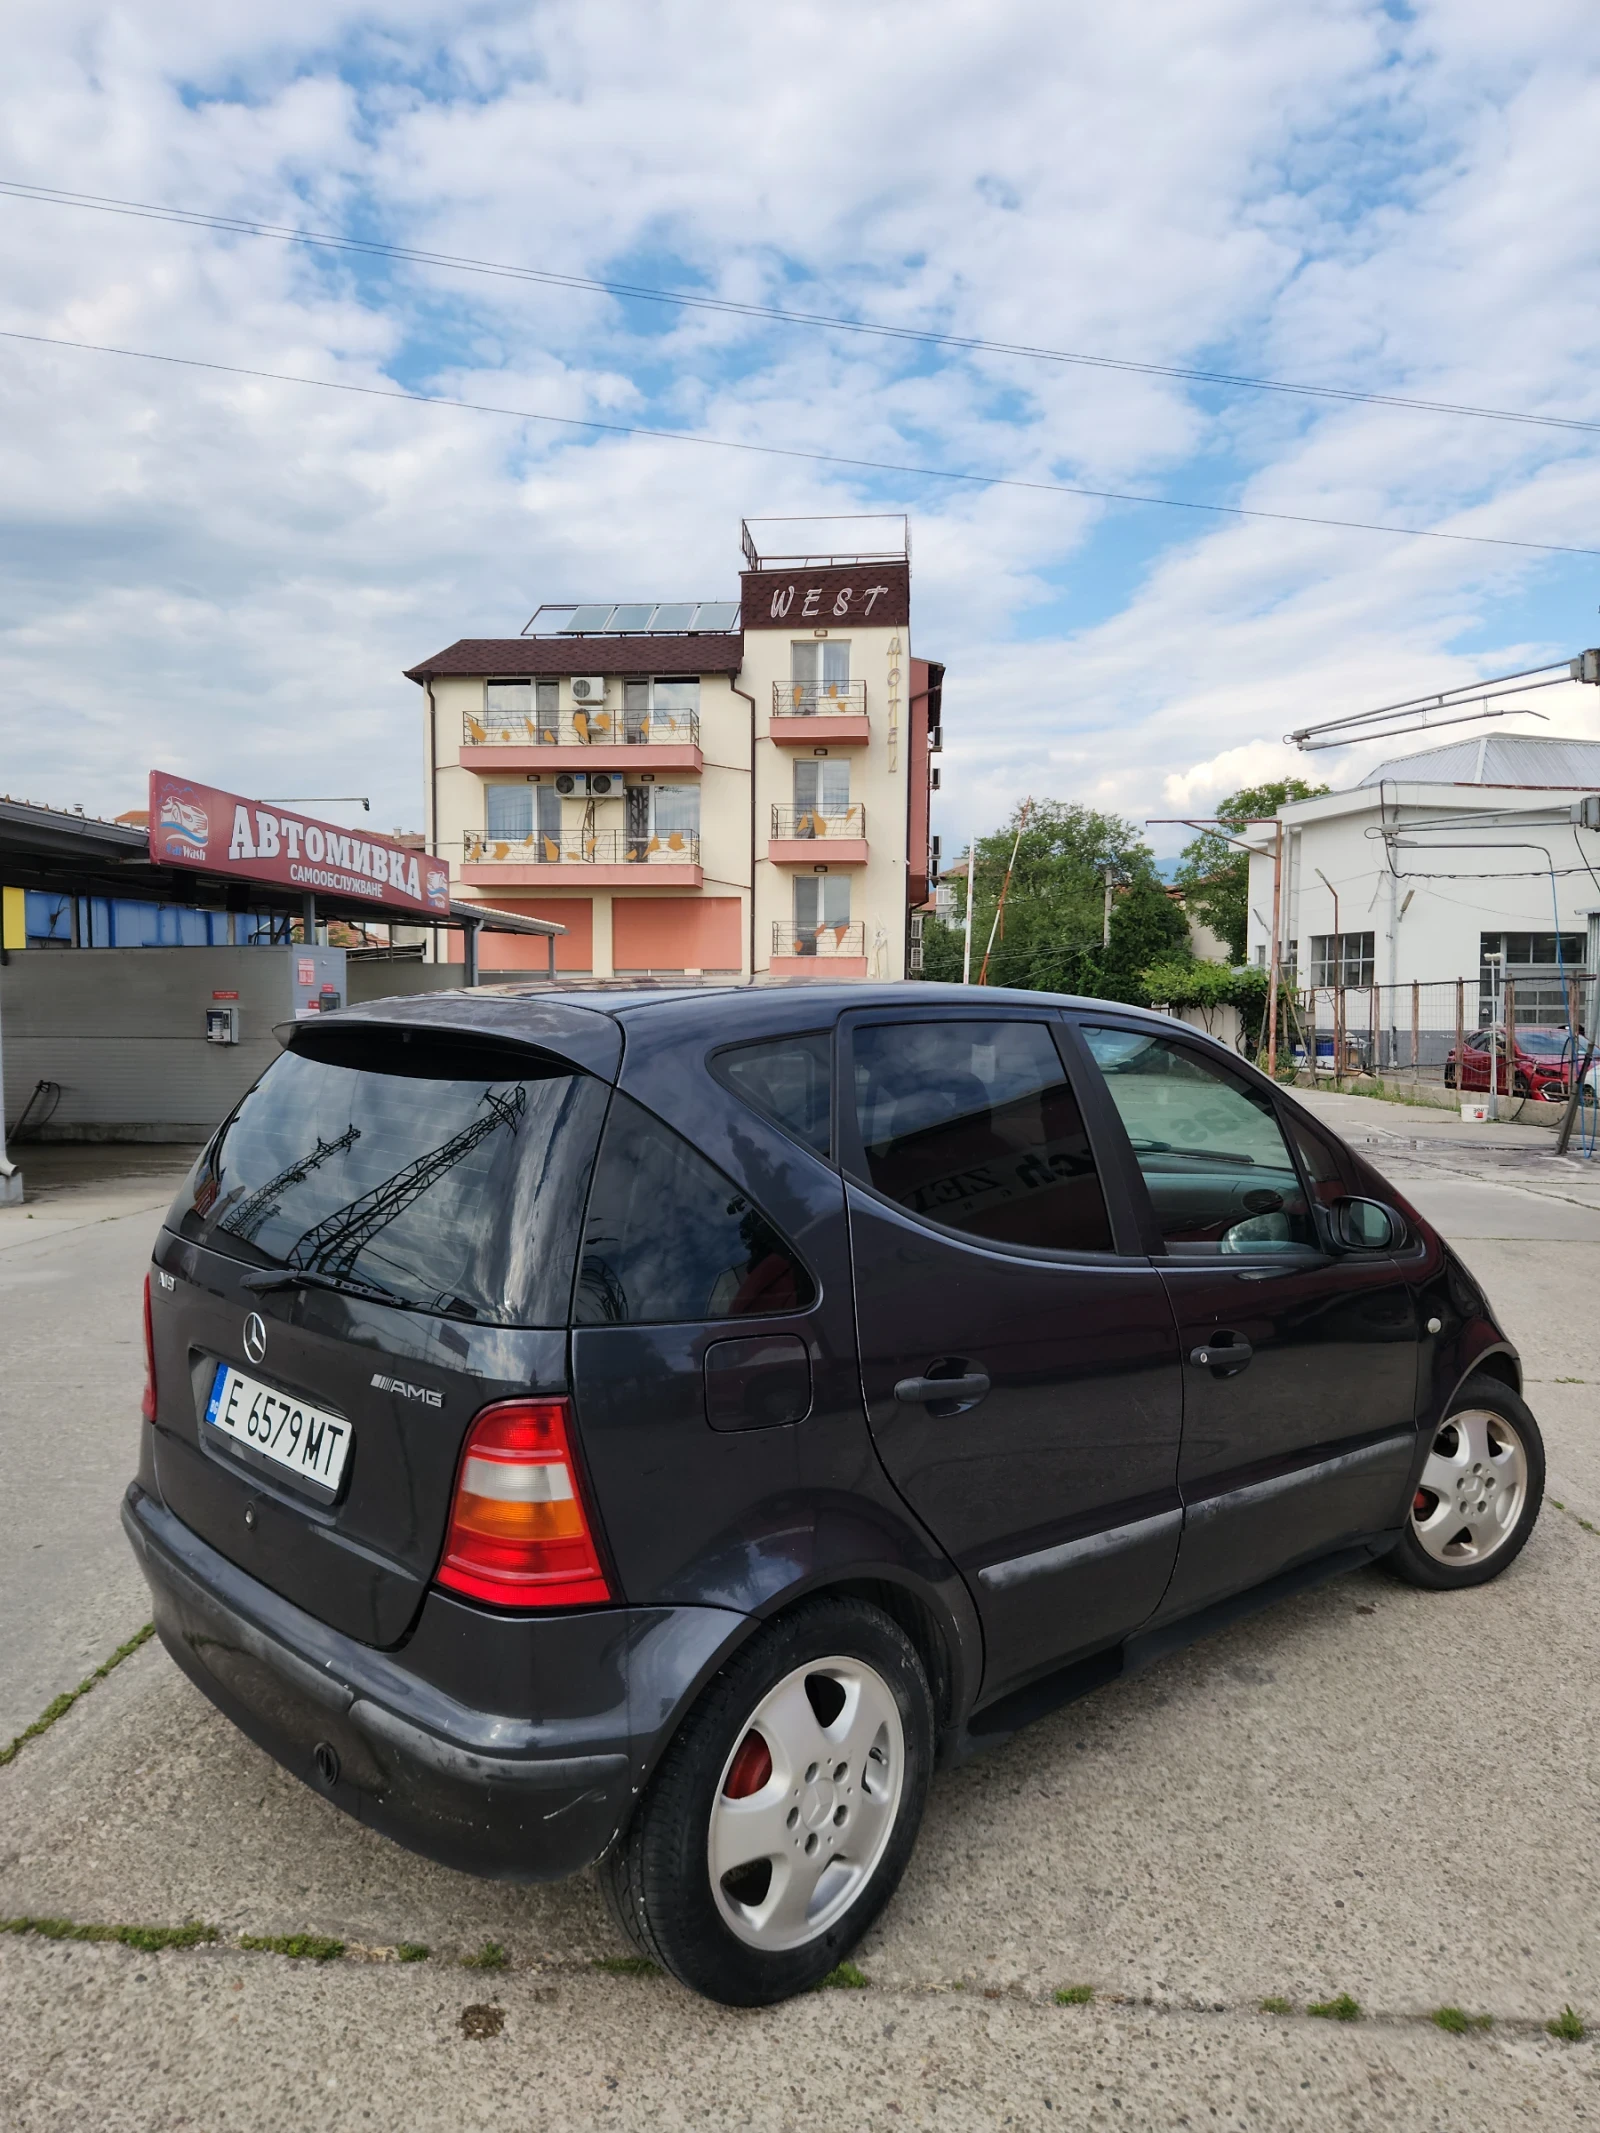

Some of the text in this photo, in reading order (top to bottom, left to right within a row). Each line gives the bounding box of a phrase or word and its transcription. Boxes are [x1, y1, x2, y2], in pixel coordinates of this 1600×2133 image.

[770, 585, 889, 618] WEST
[228, 804, 422, 901] АВТОМИВКА
[290, 863, 383, 898] САМООБСЛУЖВАНЕ
[390, 1379, 443, 1408] AMG
